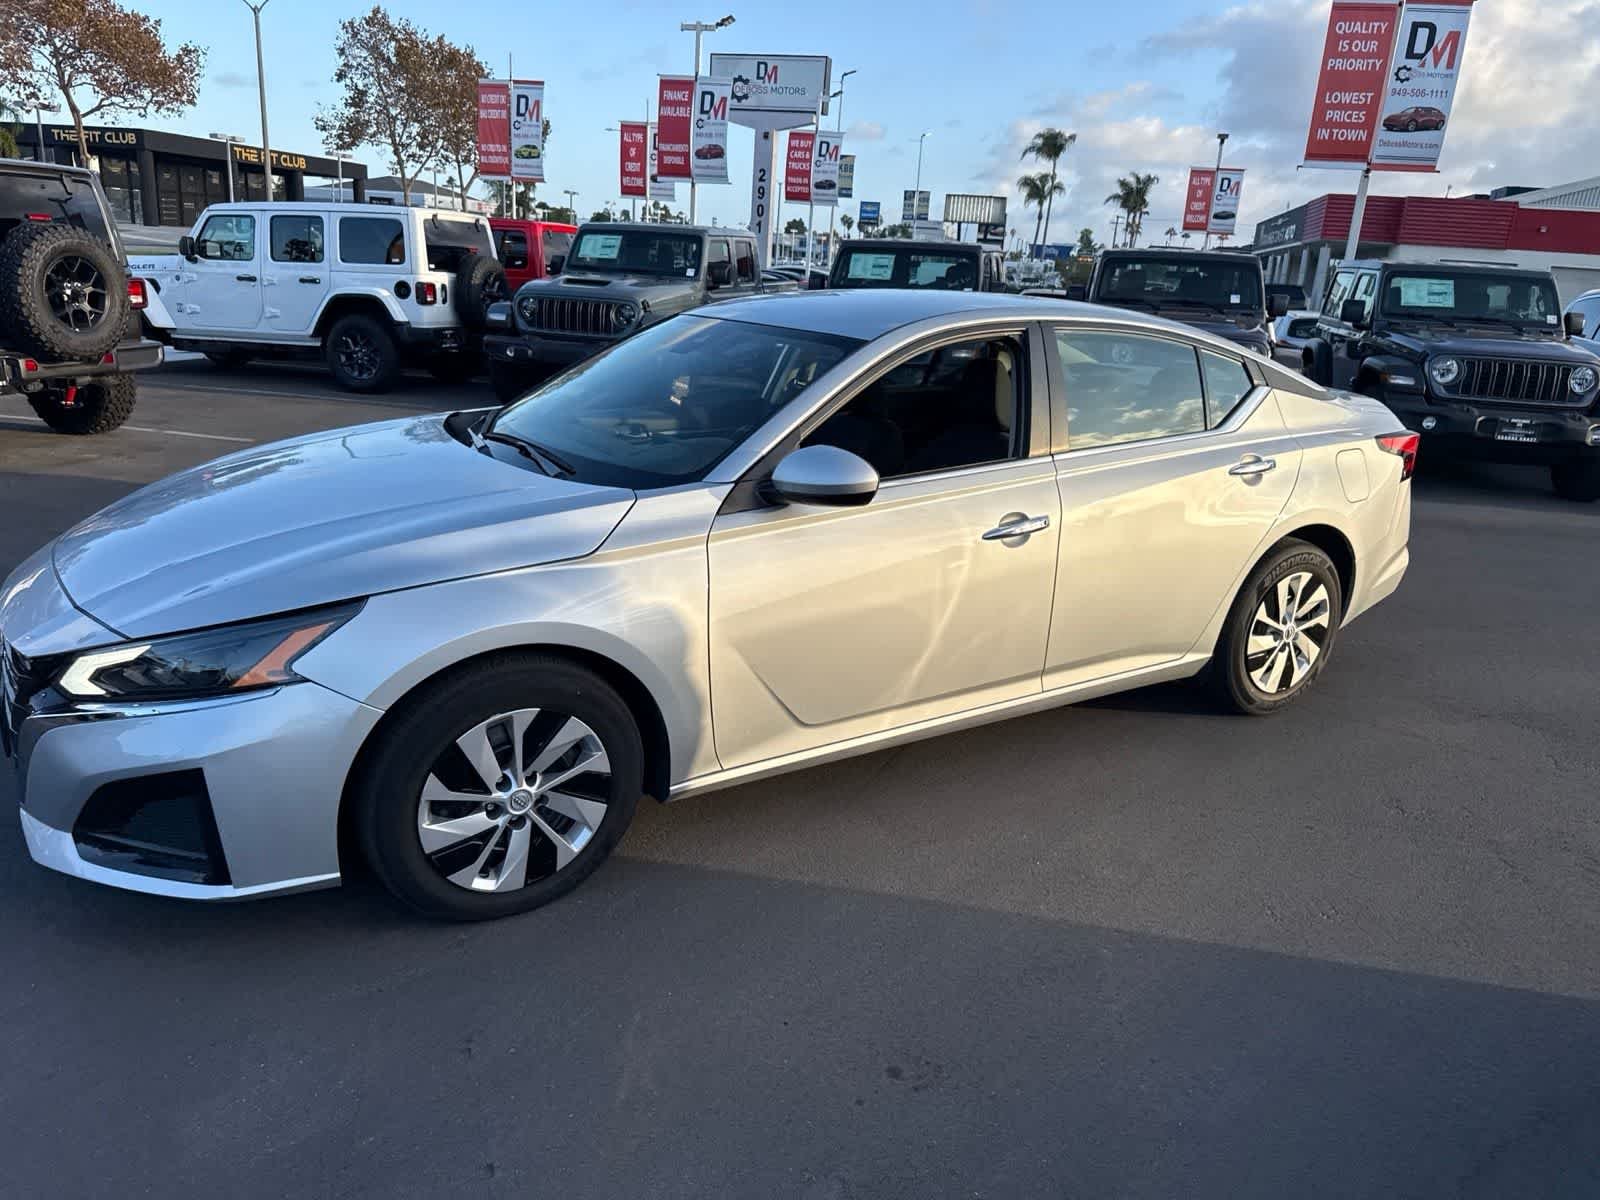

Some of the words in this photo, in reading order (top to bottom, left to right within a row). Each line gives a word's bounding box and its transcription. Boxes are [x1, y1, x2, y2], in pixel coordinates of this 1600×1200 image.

[1335, 21, 1388, 35] QUALITY
[1338, 40, 1349, 52] IS
[1352, 40, 1378, 53] OUR
[1405, 21, 1461, 70] DM
[1327, 58, 1382, 71] PRIORITY
[756, 61, 779, 84] DM
[663, 90, 688, 102] FINANCE
[770, 86, 806, 96] MOTORS
[1391, 87, 1448, 99] 949-506-1111
[700, 90, 728, 120] DM
[1325, 92, 1374, 105] LOWEST
[516, 94, 540, 122] DM
[660, 106, 690, 118] AVAILABLE
[1325, 110, 1366, 123] PRICES
[51, 128, 78, 142] THE
[104, 131, 137, 144] CLUB
[1317, 128, 1329, 140] IN
[1332, 128, 1367, 141] TOWN
[790, 140, 799, 148] WE
[800, 140, 812, 148] BUY
[233, 146, 258, 162] THE
[260, 151, 278, 164] FT
[280, 154, 306, 169] CLUB
[789, 150, 804, 159] CARS
[818, 141, 840, 161] DM
[788, 162, 810, 170] TRUCKS
[1219, 177, 1241, 196] DM
[755, 168, 766, 233] 2901
